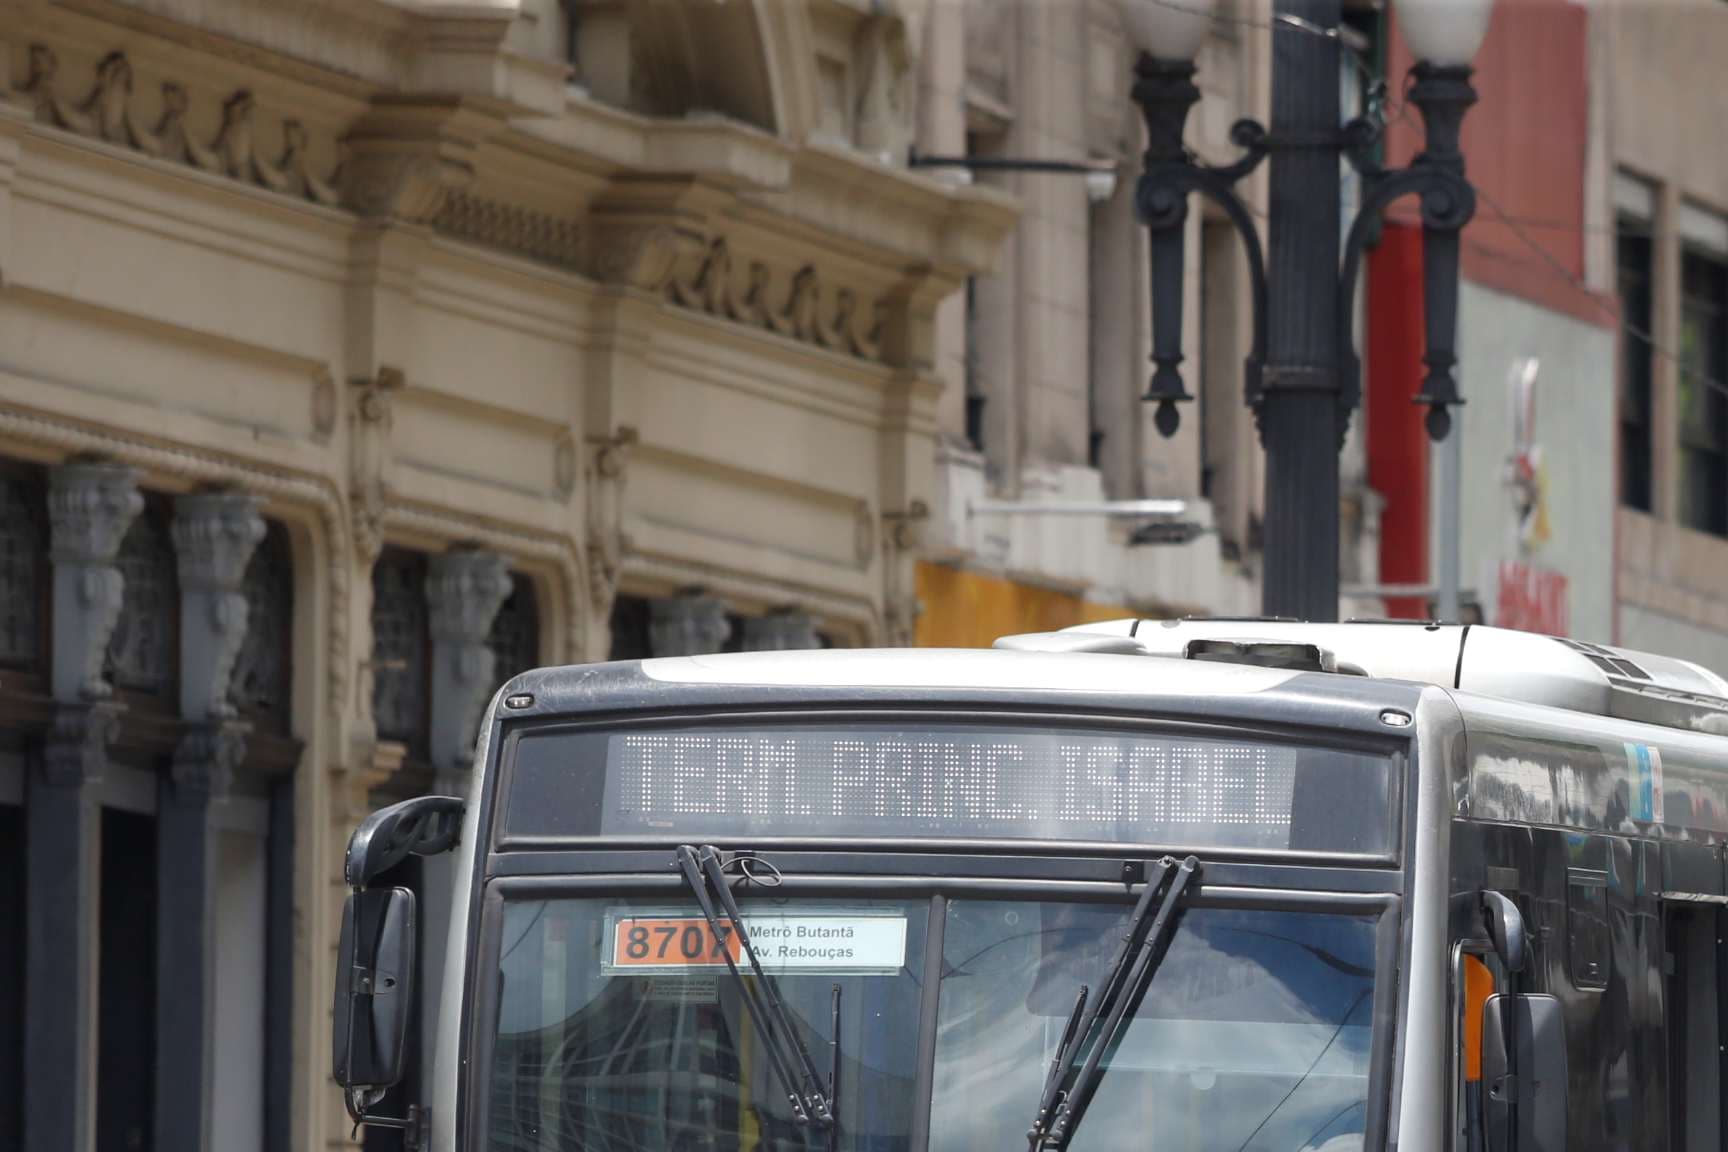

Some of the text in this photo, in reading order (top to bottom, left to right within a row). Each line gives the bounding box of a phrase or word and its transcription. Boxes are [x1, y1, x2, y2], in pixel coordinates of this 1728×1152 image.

[626, 736, 1292, 825] TERM. PRINC. ISABEL
[750, 925, 854, 939] Metrô Butantã
[751, 945, 854, 960] Av. Rebouças
